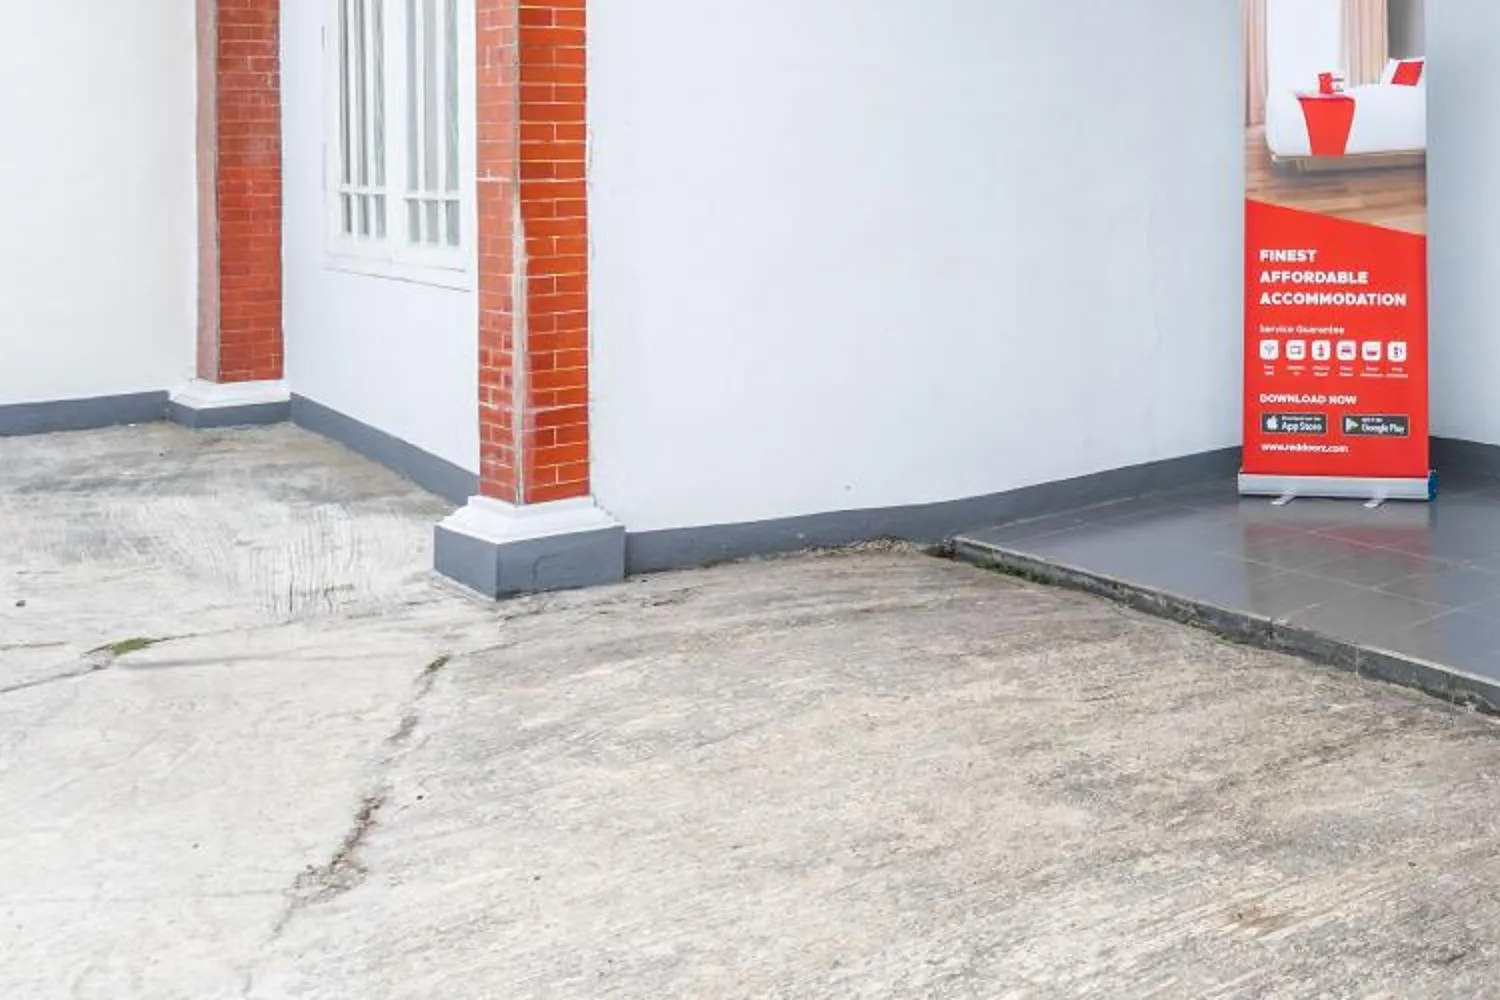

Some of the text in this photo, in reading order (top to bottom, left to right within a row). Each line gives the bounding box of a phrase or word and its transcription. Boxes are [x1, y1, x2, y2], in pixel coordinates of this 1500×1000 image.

[1260, 249, 1317, 262] FINEST
[1260, 271, 1369, 284] AFFORDABLE
[1260, 292, 1407, 306] ACCOMMODATION
[1259, 324, 1294, 334] Service
[1259, 393, 1357, 405] DOWNLOAD NOW
[1282, 422, 1322, 432] App Store
[1361, 423, 1389, 434] Google
[1261, 443, 1349, 454] www.reddoorz.com
